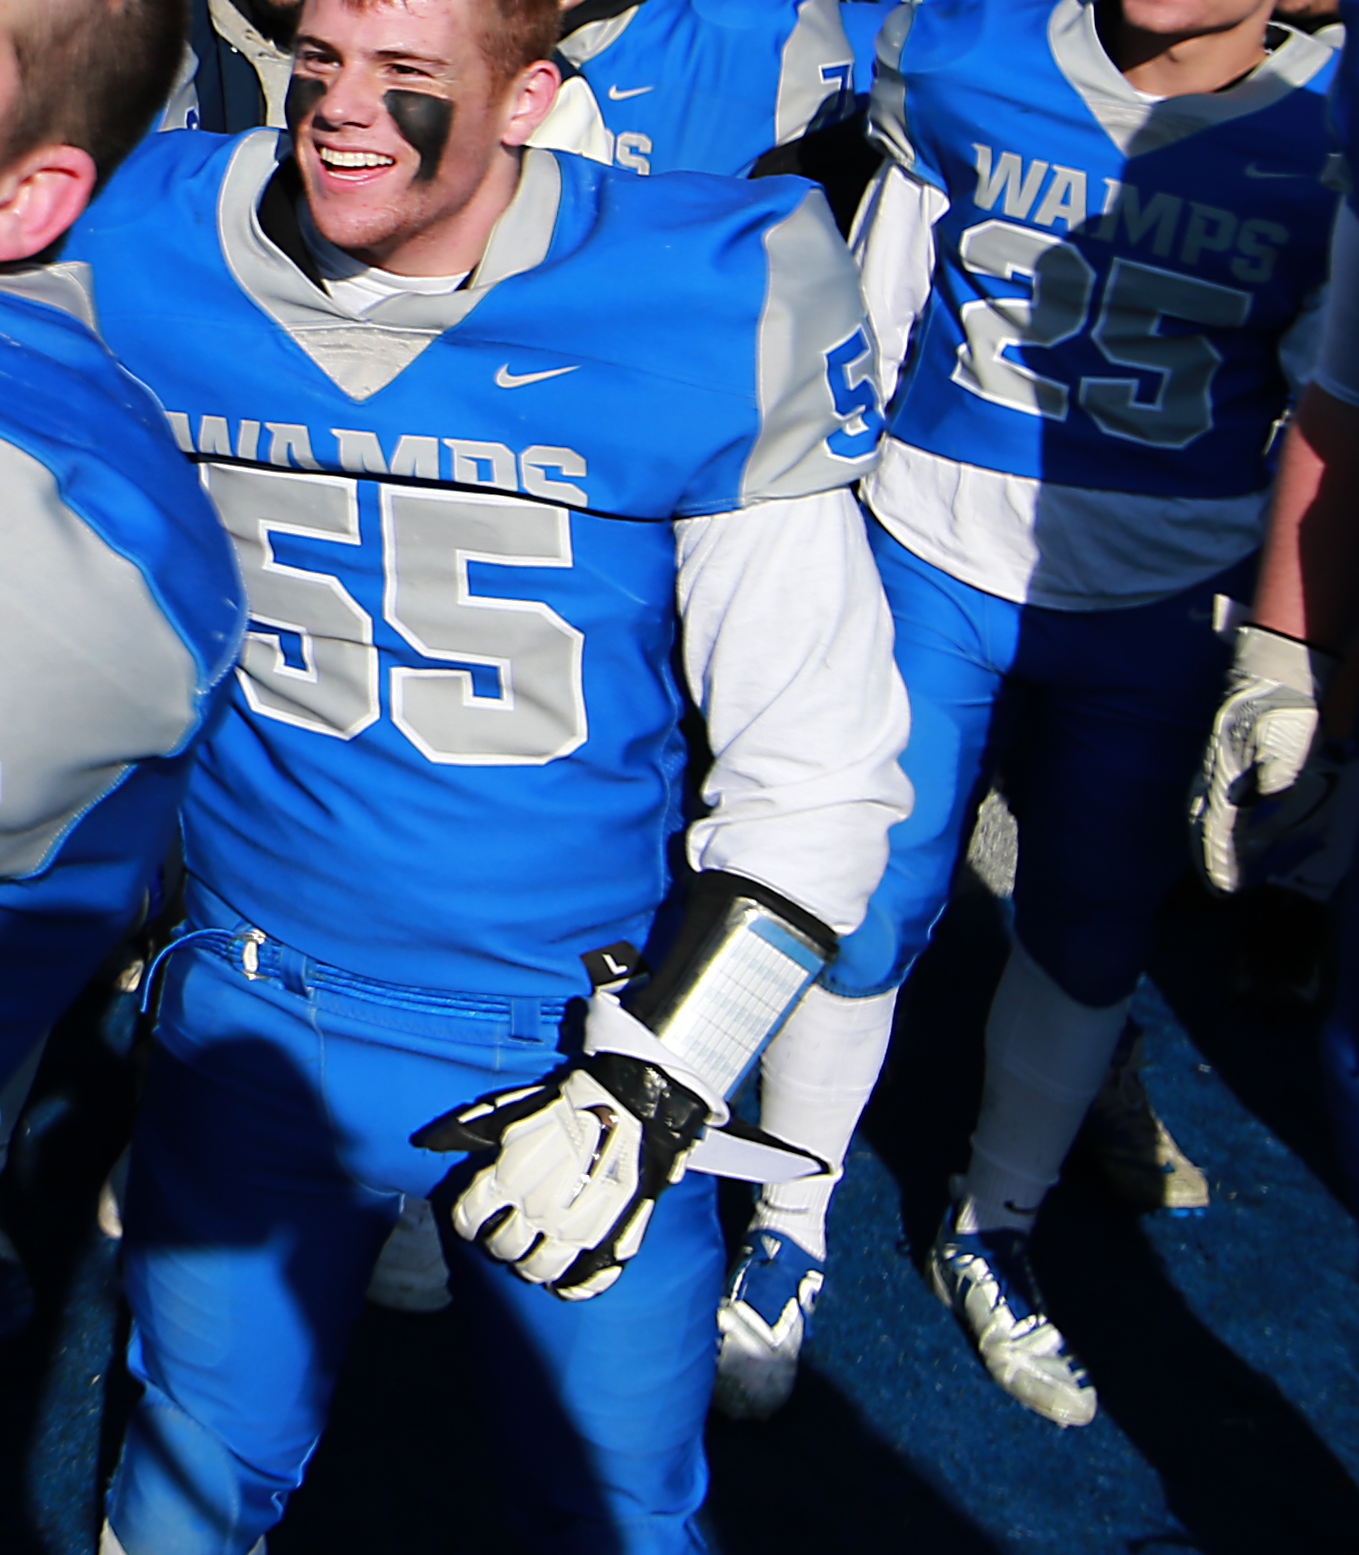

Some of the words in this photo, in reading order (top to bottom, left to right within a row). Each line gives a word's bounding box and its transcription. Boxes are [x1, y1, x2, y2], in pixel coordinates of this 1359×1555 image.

[971, 142, 1289, 283] WAMPS
[950, 218, 1253, 450] 25
[198, 460, 589, 767] 55
[601, 952, 629, 976] L
